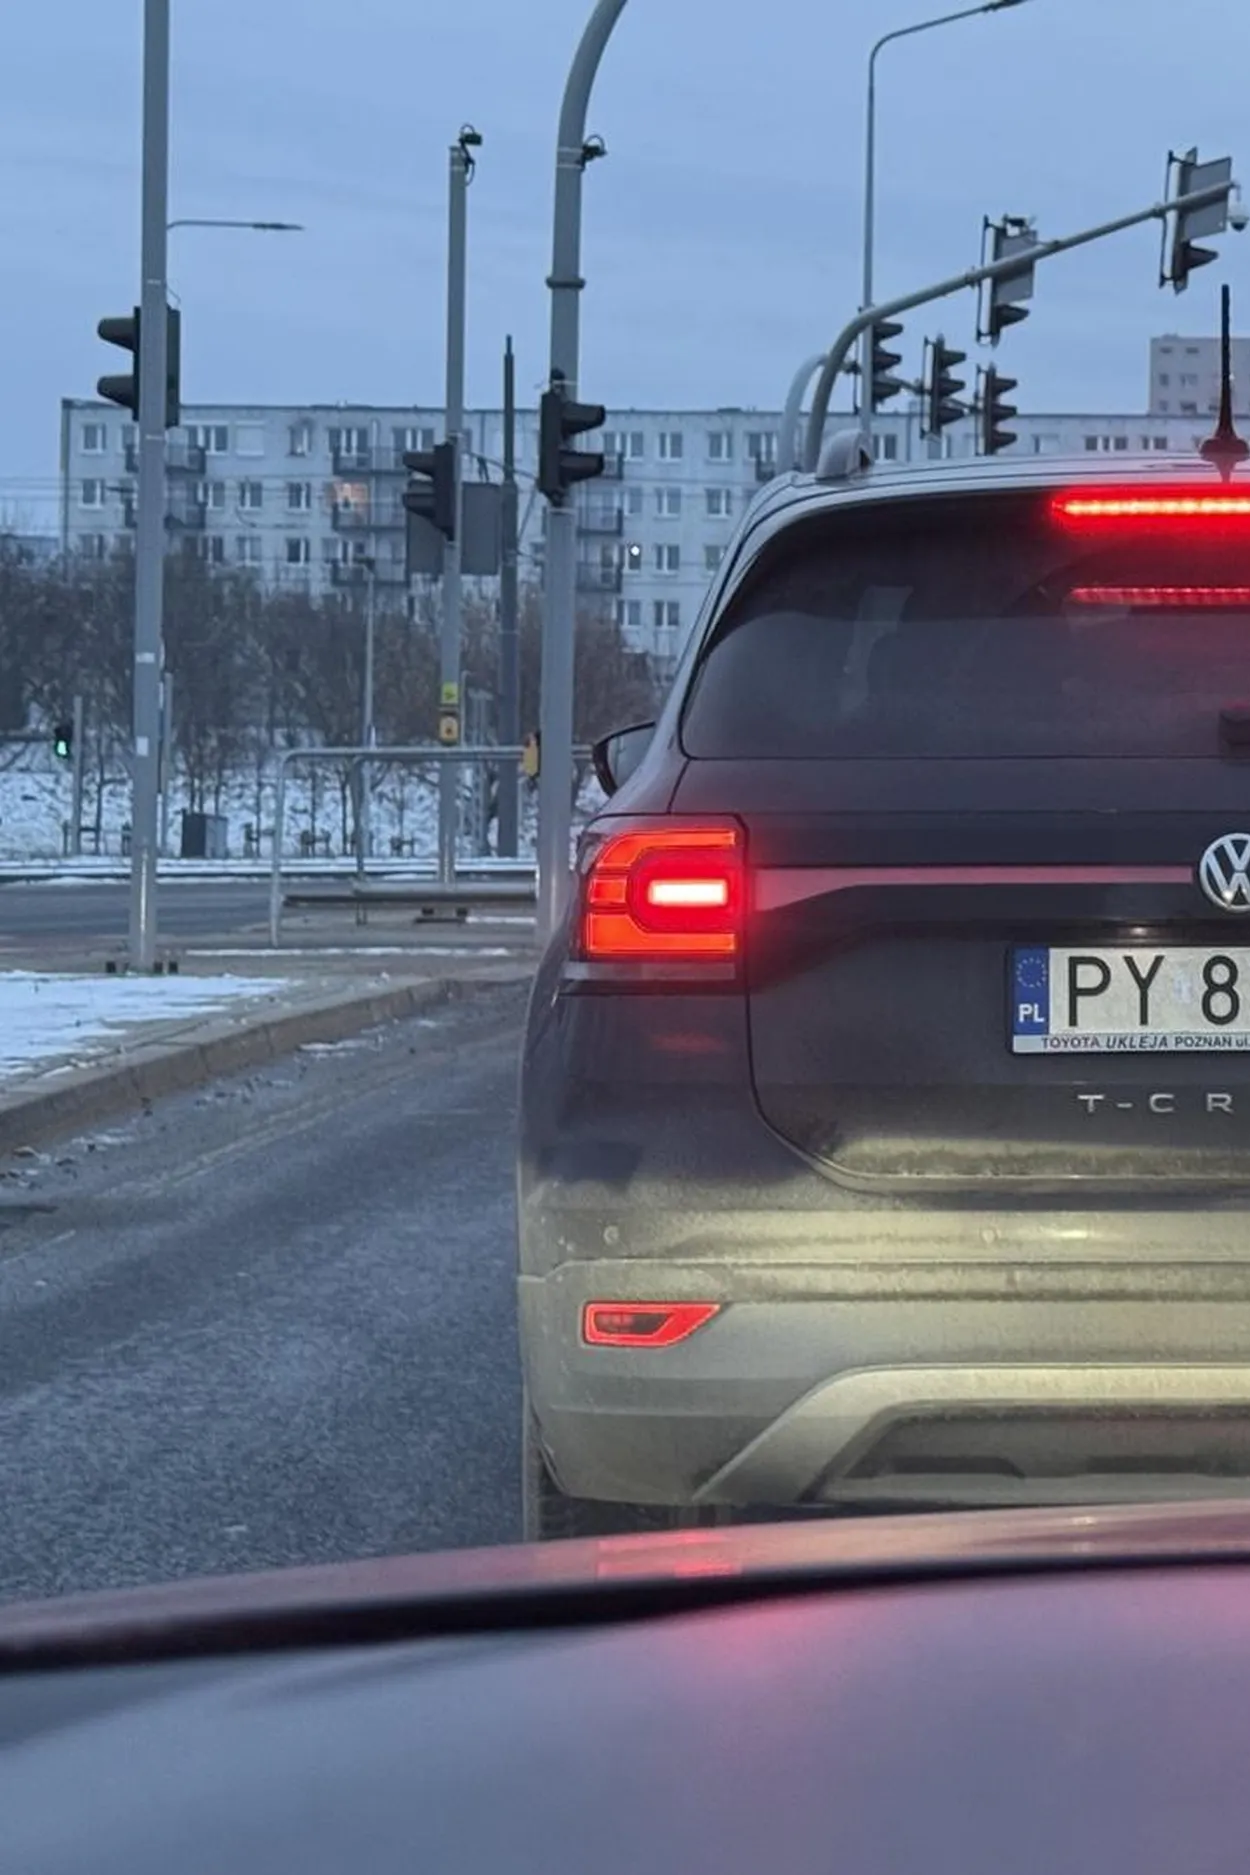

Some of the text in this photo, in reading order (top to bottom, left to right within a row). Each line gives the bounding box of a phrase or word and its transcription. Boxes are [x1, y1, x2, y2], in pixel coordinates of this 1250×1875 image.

[1068, 954, 1165, 1027] PY
[1018, 1003, 1045, 1023] PL
[1041, 1035, 1100, 1049] TOYOTA
[1106, 1035, 1168, 1049] UKLEJA
